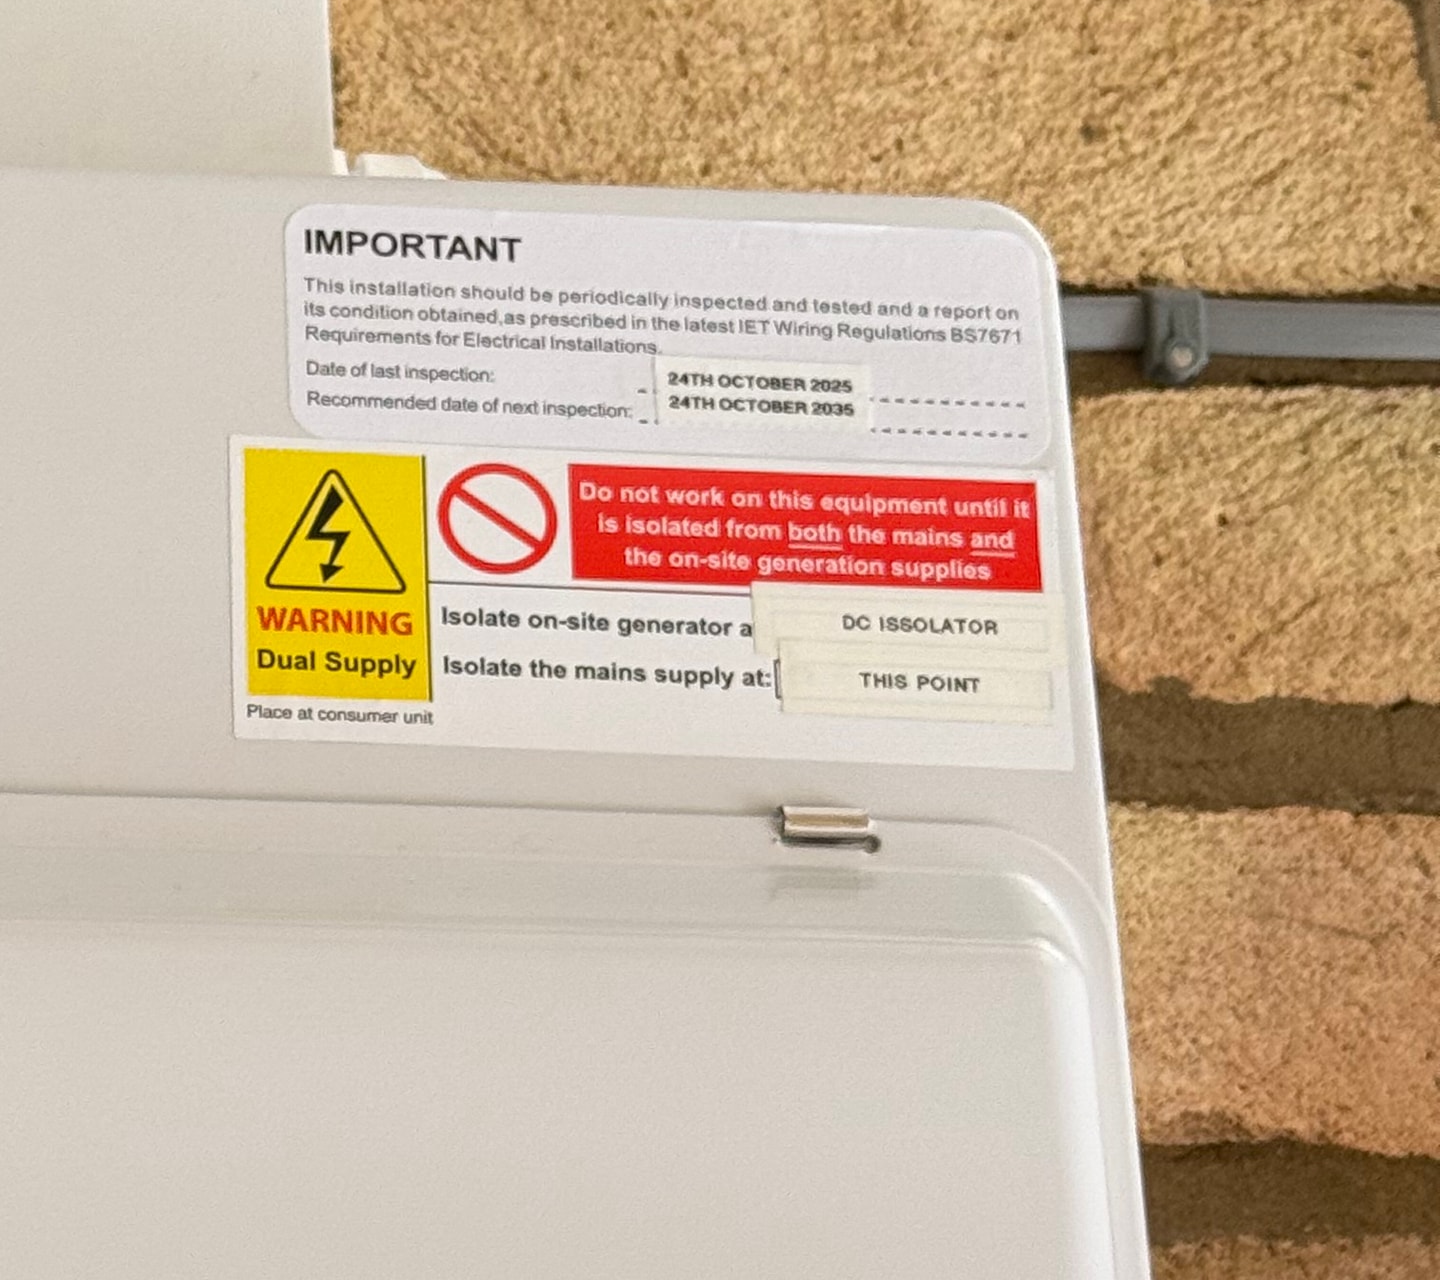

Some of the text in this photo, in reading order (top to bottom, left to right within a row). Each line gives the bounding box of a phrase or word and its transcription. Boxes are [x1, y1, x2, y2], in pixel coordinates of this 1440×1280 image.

[303, 228, 522, 263] IMPORTANT
[304, 277, 1019, 321] This installation should be periodically inspected and tested and a report on
[303, 302, 325, 318] its
[329, 303, 414, 321] condition
[530, 311, 627, 331] prescribed
[631, 315, 647, 331] in
[651, 318, 681, 332] the
[683, 318, 735, 334] latest
[738, 319, 770, 335] IET
[774, 320, 833, 339] Wiring
[837, 323, 947, 342] Regulations
[951, 327, 1021, 344] BS7671
[304, 326, 431, 346] Requirements
[435, 330, 460, 347] for
[463, 332, 546, 350] Electrical
[306, 360, 495, 384] Date of last inspection:
[668, 372, 853, 393] 24TH OCTOBER 2025
[307, 391, 634, 420] Recommended date of next inspection:
[669, 396, 855, 417] 24TH OCTOBER 2035
[579, 482, 1030, 520] Do not work on this equipment until it
[598, 515, 1015, 549] is isolated from both the mains and
[624, 547, 991, 581] the on-site generation supplies
[257, 605, 414, 636] WARNING
[441, 607, 520, 629] Isolate
[527, 610, 610, 633] on-site
[618, 615, 733, 639] generator
[842, 614, 998, 635] DC ISSOLATOR
[256, 648, 416, 680] Dual Supply
[443, 656, 772, 690] Isolate the mains supply at:
[859, 672, 980, 693] THIS POINT
[247, 704, 434, 724] Place at consumer unit
